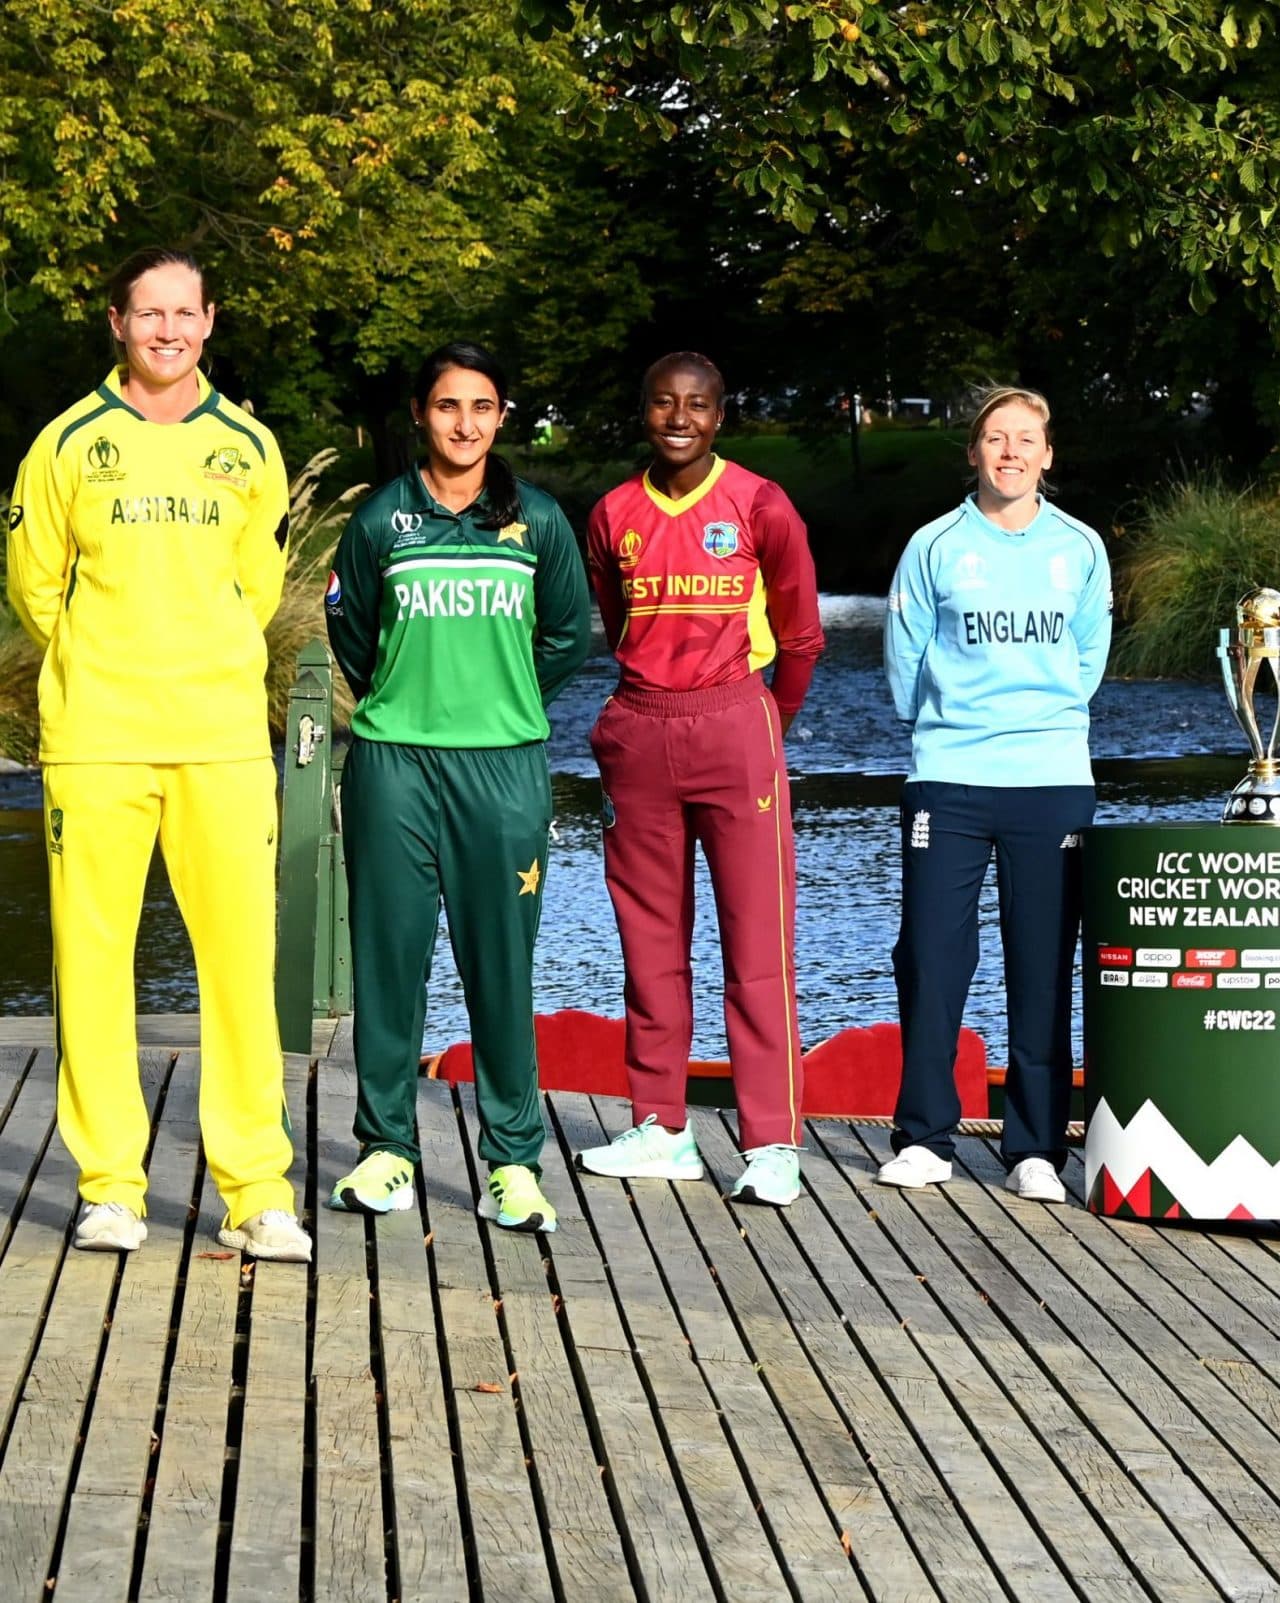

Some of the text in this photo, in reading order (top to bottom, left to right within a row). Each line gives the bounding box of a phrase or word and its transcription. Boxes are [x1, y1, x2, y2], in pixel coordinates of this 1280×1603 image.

[667, 574, 744, 596] INDIES
[394, 579, 525, 620] PAKISTAN
[964, 610, 1064, 645] ENGLAND
[1156, 852, 1192, 874] ICC
[1117, 878, 1211, 899] CRICKET
[1129, 906, 1178, 926] NEW
[1101, 952, 1128, 960] NISSAN
[1204, 1010, 1276, 1030] #CWC22
